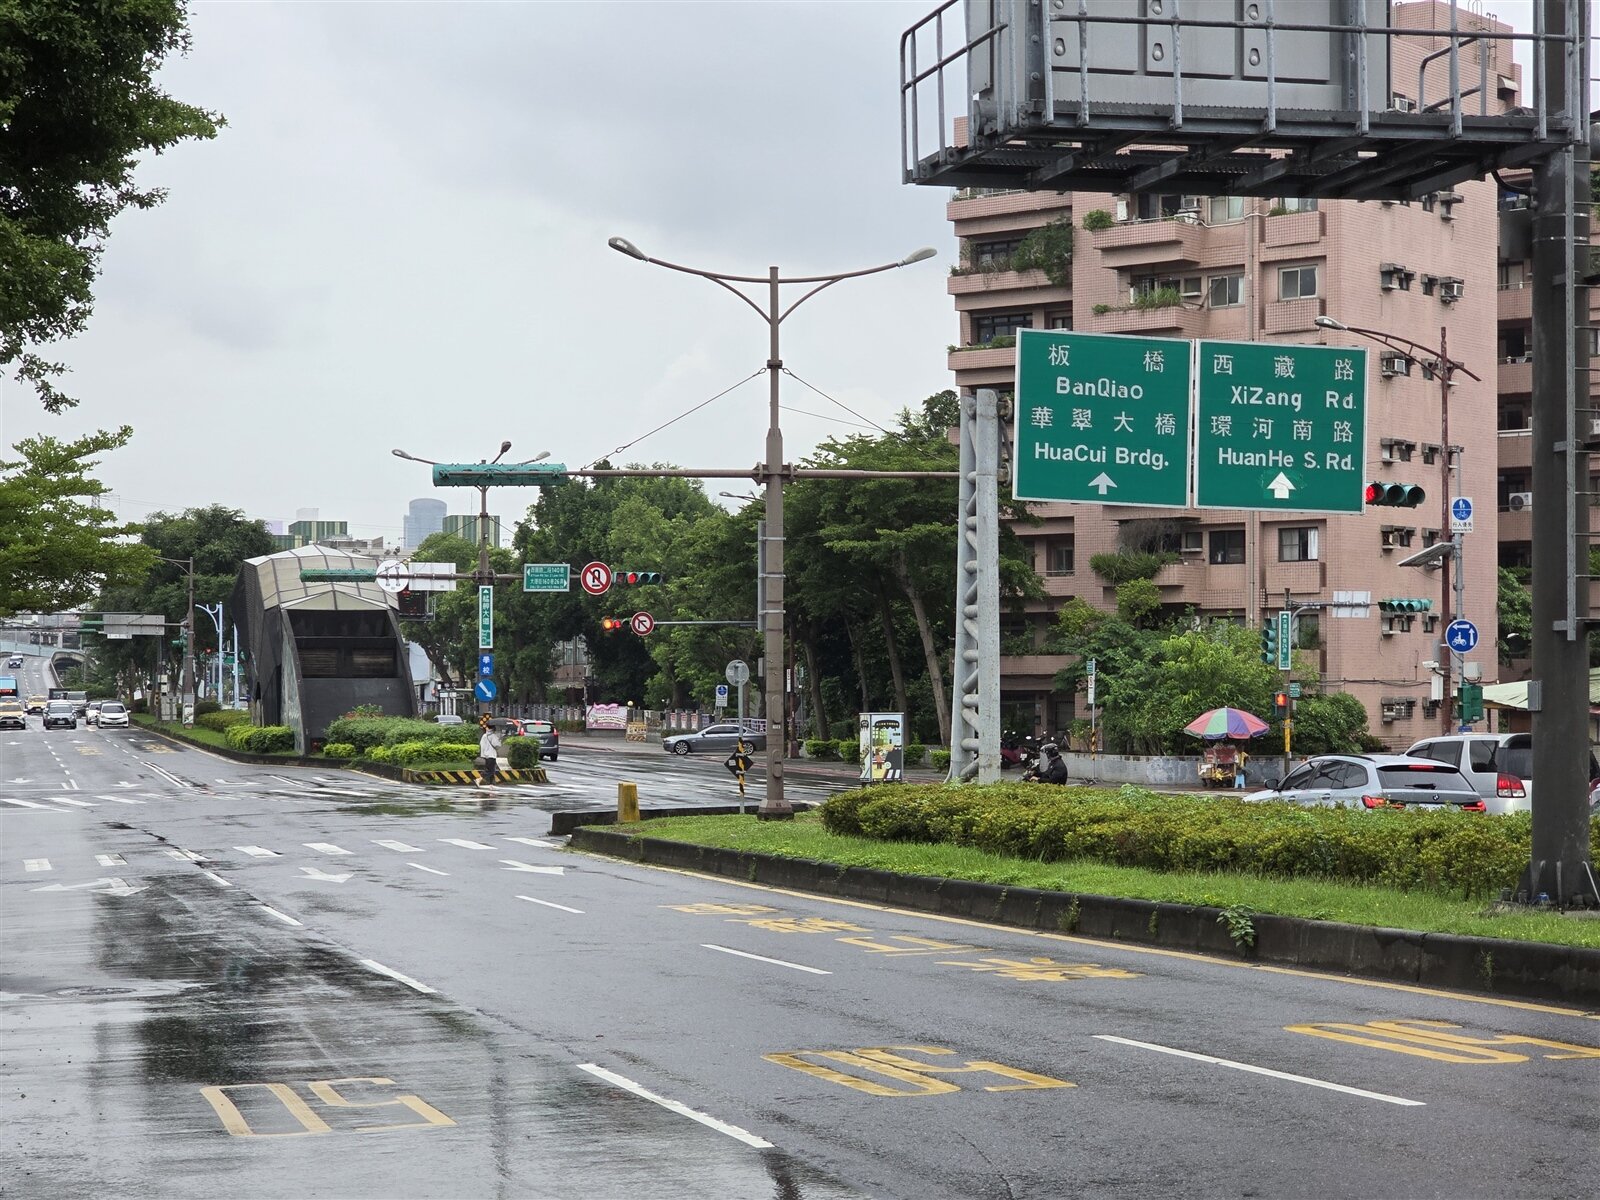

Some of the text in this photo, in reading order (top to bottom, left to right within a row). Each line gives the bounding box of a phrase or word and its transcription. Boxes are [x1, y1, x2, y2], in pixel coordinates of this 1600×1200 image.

[1048, 343, 1164, 373] 板橋
[1213, 353, 1354, 381] 西藏路
[1056, 376, 1143, 399] BanQiao
[1230, 386, 1357, 410] XiZang Rd.
[1031, 407, 1176, 436] 華翠大橋
[1211, 415, 1353, 443] 環河南路
[1034, 442, 1169, 470] HuaCui Brdg.
[1218, 447, 1355, 471] HuanHe S. Rd.
